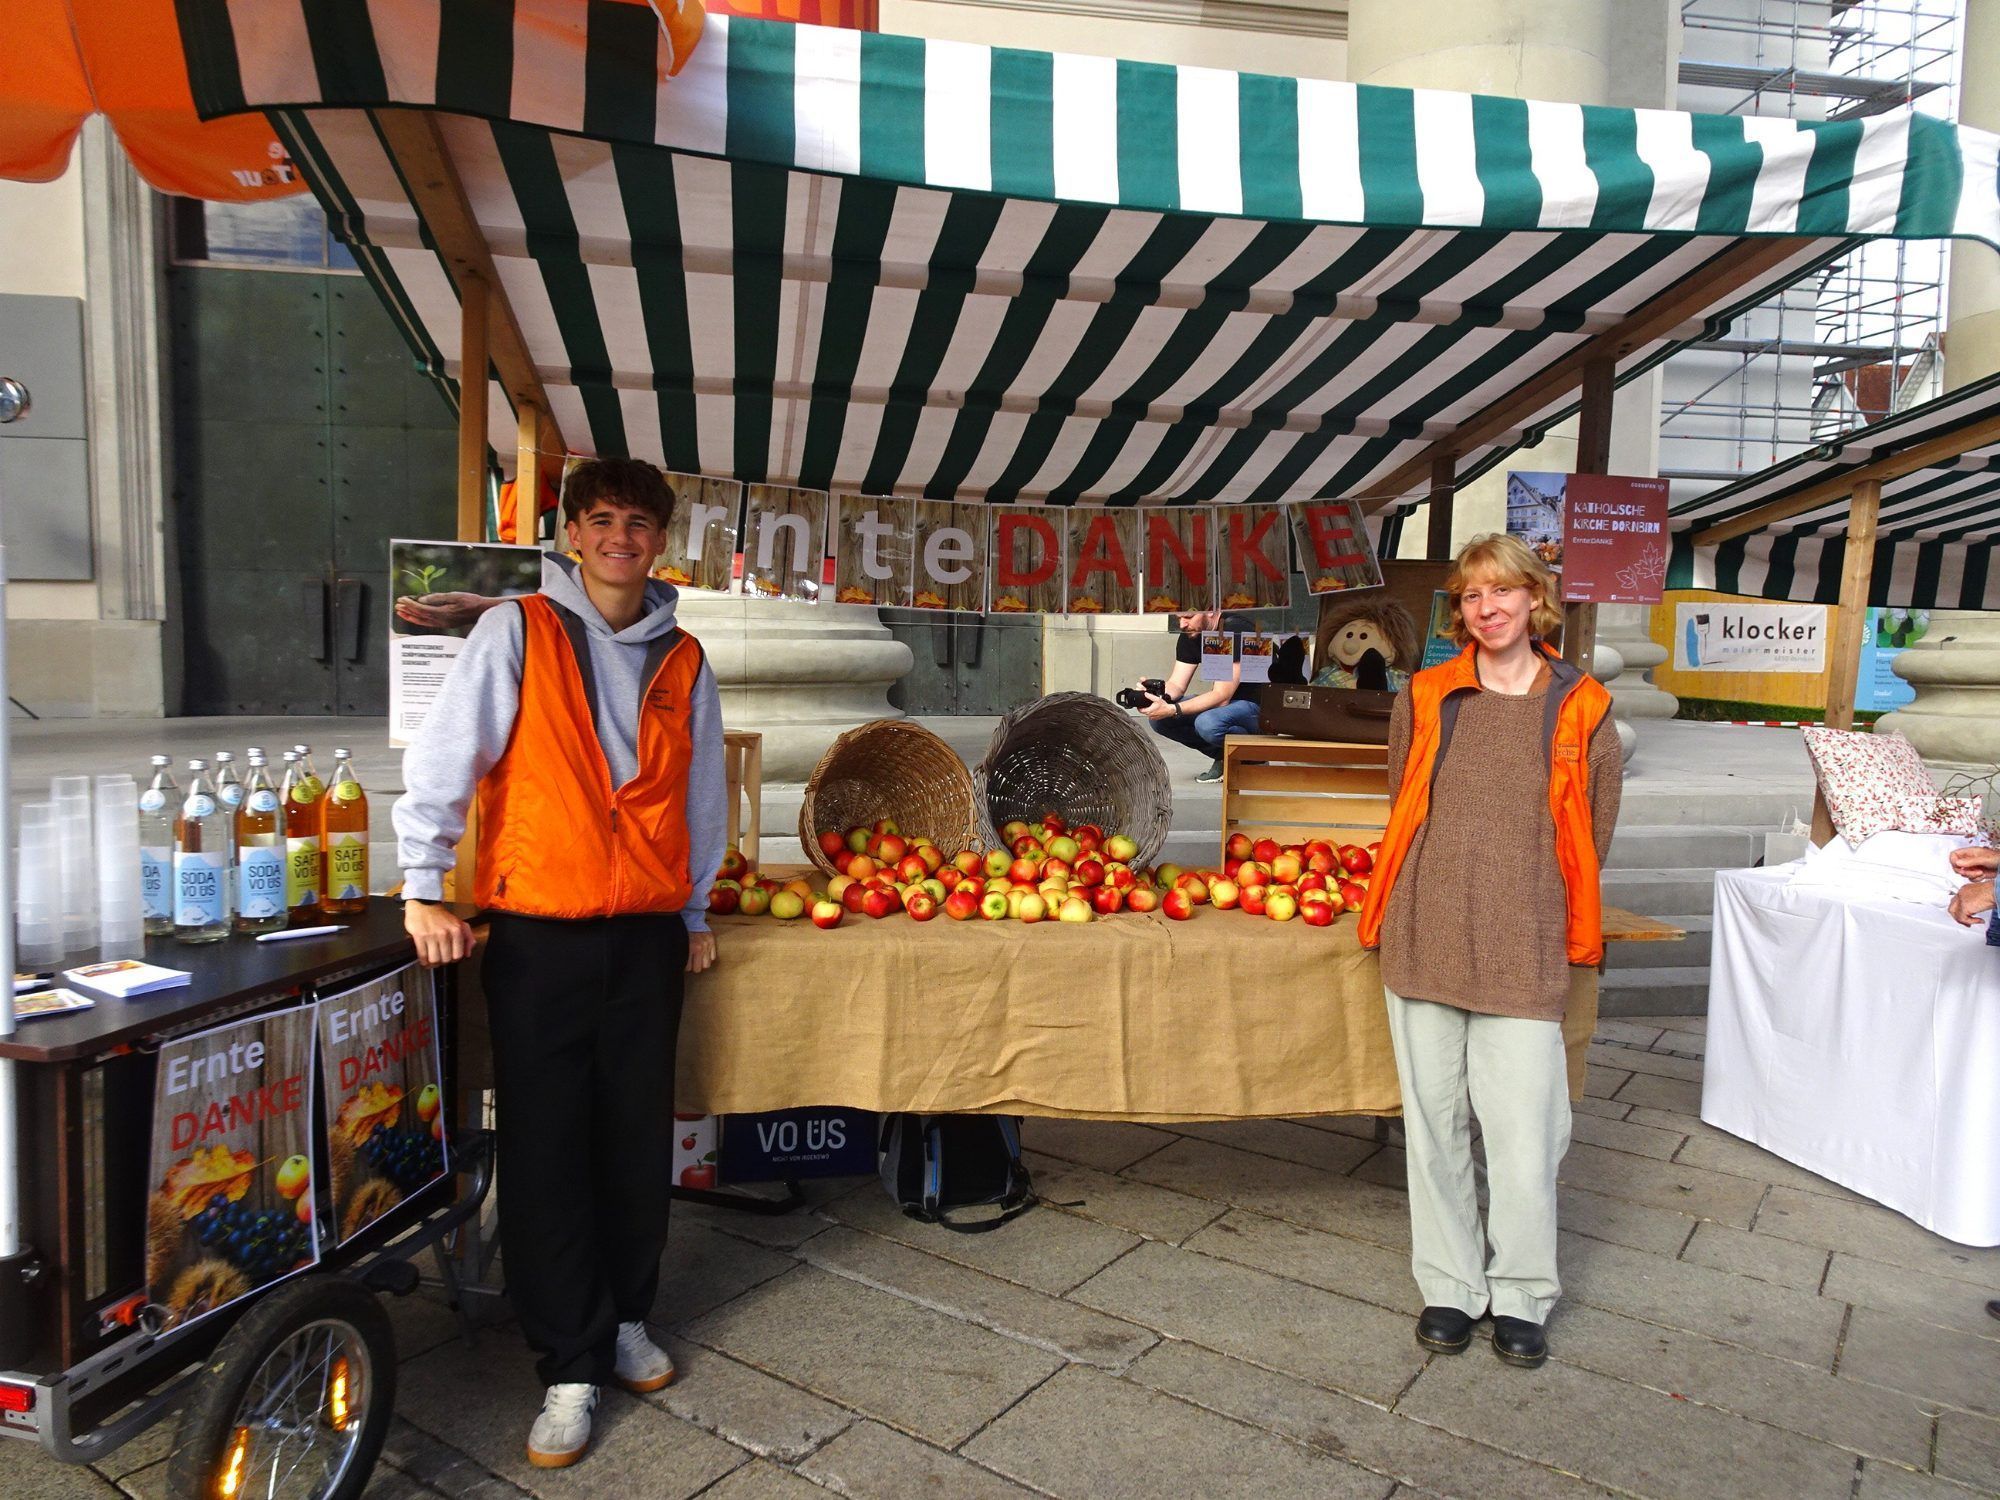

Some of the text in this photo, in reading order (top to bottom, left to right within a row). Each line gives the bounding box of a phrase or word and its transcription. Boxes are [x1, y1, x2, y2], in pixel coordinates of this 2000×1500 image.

[1574, 502, 1647, 517] KATHOLISCHE
[1573, 518, 1660, 534] KIRCHE DORNBIRN
[1572, 536, 1614, 545] ErnteDANKE
[1723, 615, 1816, 641] klocker
[335, 849, 364, 861] SAFT
[248, 865, 282, 878] SODA
[294, 867, 309, 878] VO
[335, 862, 350, 872] VO
[181, 872, 216, 884] SODA
[249, 878, 264, 889] VO
[181, 886, 197, 897] VO
[329, 990, 405, 1046] Ernte
[338, 1018, 433, 1091] DANKE
[166, 1040, 265, 1096] Ernte
[171, 1076, 302, 1151] DANKE
[757, 1121, 798, 1153] VO
